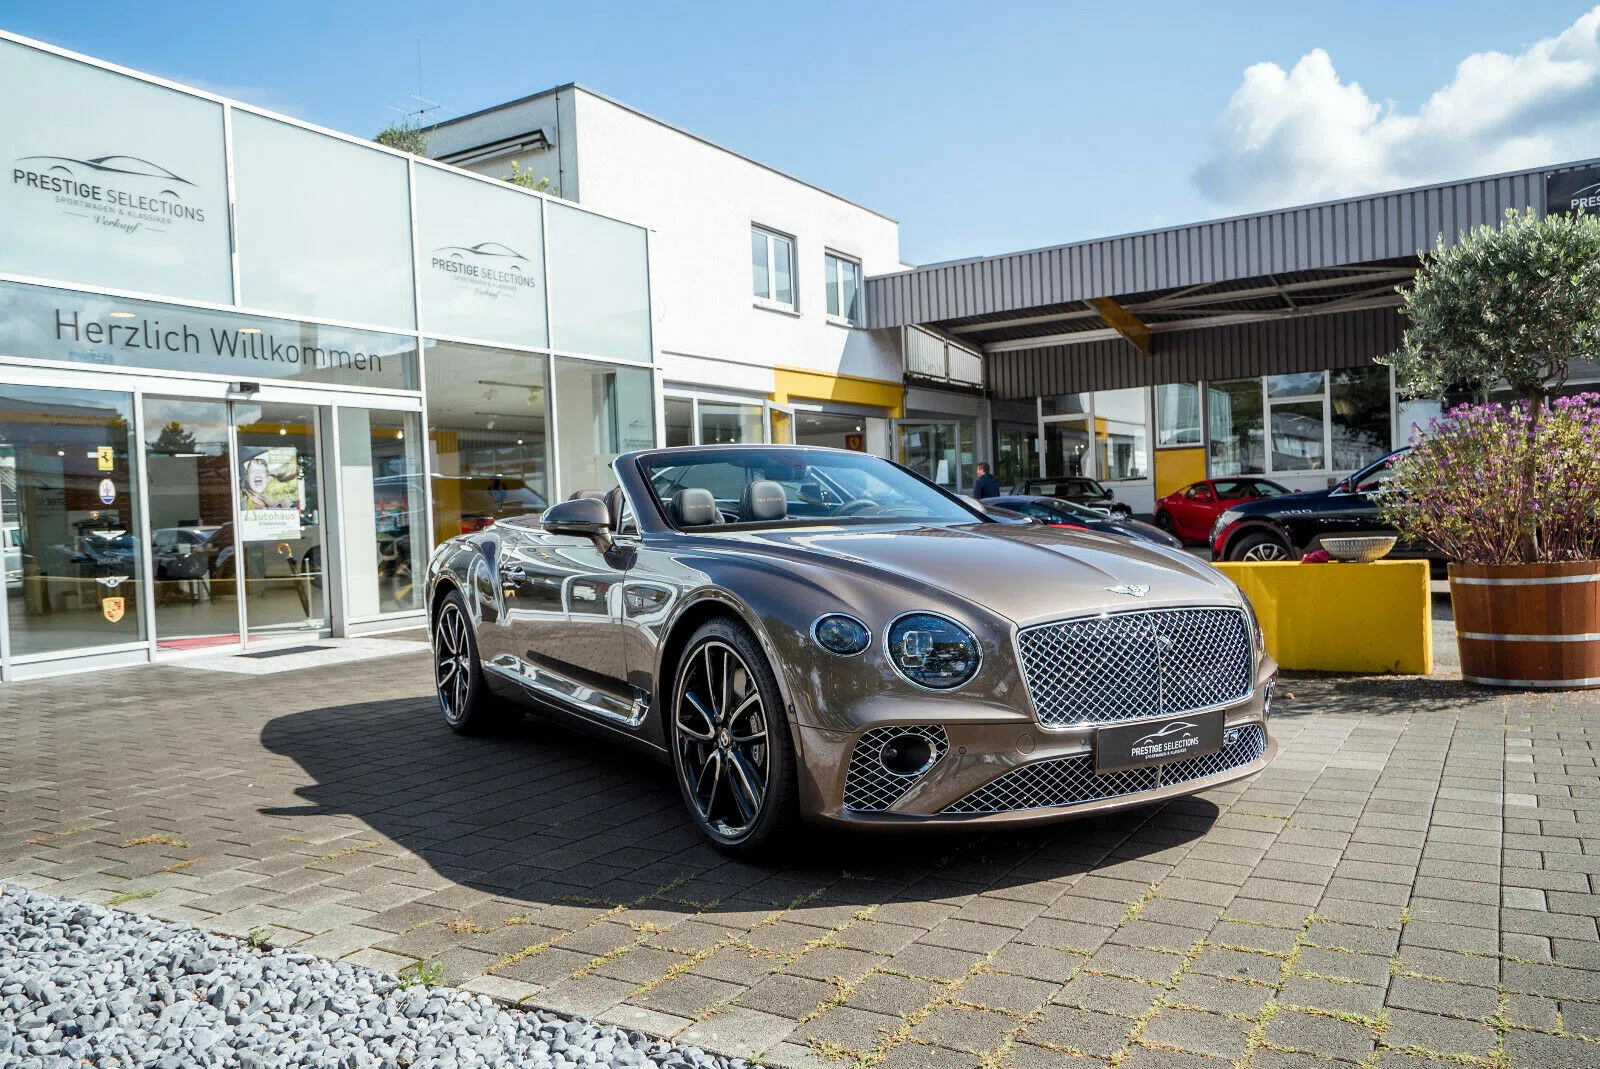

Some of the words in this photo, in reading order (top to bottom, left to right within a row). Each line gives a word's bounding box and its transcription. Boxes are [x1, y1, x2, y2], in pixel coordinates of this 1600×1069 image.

[13, 168, 102, 201] PRESTIGE
[107, 189, 205, 222] SELECTIONS
[55, 195, 115, 214] SPORTWAGEN
[432, 257, 479, 277] PRESTIGE
[481, 267, 536, 288] SELECTIONS
[55, 308, 201, 354] Herzlich
[210, 327, 383, 372] Willkommen
[1131, 744, 1163, 757] PRESTIGE
[1163, 737, 1198, 750] SELECTIONS
